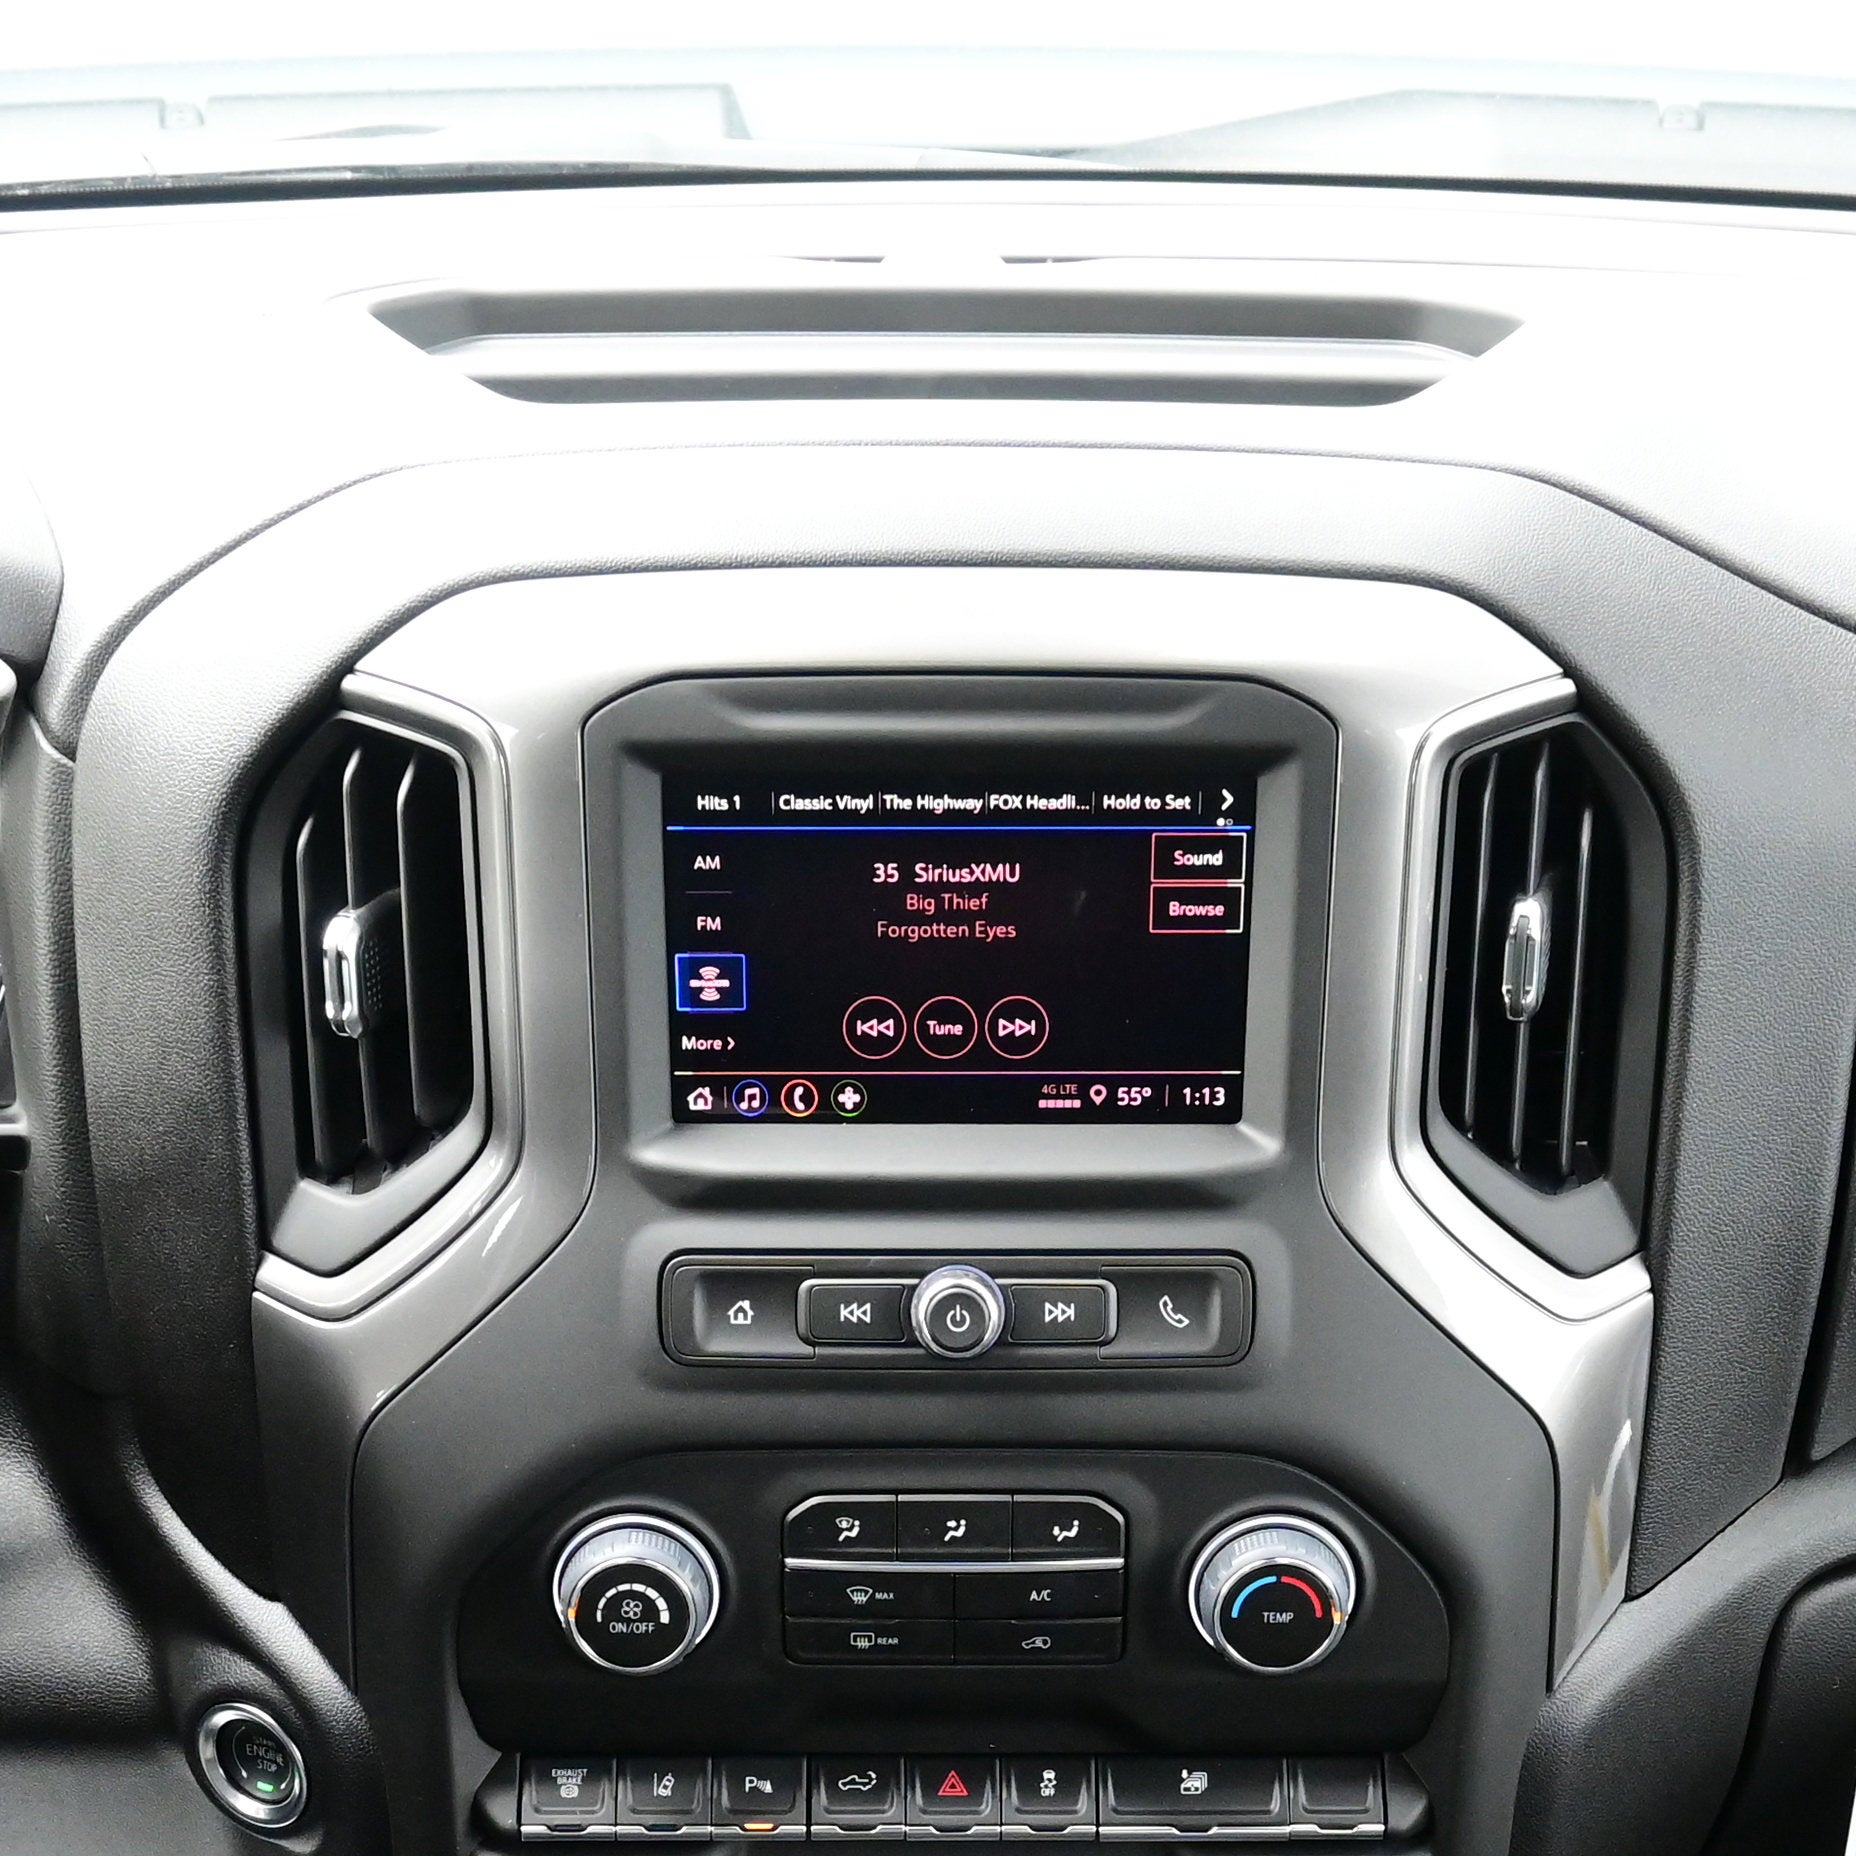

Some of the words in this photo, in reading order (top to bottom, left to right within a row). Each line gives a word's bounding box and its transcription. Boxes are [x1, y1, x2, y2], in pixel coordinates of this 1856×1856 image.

[696, 794, 729, 811] Hits
[733, 795, 741, 811] 1
[778, 794, 833, 811] Classic
[835, 794, 874, 814] Vinyl
[882, 794, 912, 811] The
[915, 794, 984, 814] Highway
[989, 794, 1023, 811] FOX
[1025, 794, 1091, 811] Headli...
[1102, 794, 1141, 811] Hold
[1144, 796, 1161, 811] to
[1165, 794, 1192, 811] Set
[693, 855, 721, 871] AM
[1173, 850, 1224, 866] Sound
[872, 863, 900, 884] 35
[913, 863, 1021, 884] SiriusXMU
[905, 893, 936, 915] Big
[940, 893, 990, 911] Thief
[1168, 901, 1225, 917] Browse
[696, 916, 722, 932] FM
[876, 921, 970, 943] Forgotten
[974, 920, 1017, 943] Eyes
[926, 1020, 964, 1036] Tune
[681, 1036, 723, 1051] More
[1041, 1084, 1057, 1095] 4G
[1059, 1084, 1079, 1095] LTE
[1182, 1086, 1226, 1107] 1:13
[875, 1592, 895, 1601] MAX
[1029, 1589, 1052, 1602] A/C
[1262, 1611, 1295, 1624] TEMP
[609, 1622, 656, 1635] ON/OFF
[877, 1637, 899, 1646] REAR
[256, 1759, 278, 1773] STOP
[551, 1768, 588, 1778] EXHAUST
[556, 1777, 583, 1786] BRAKE
[1040, 1788, 1056, 1797] OFF
